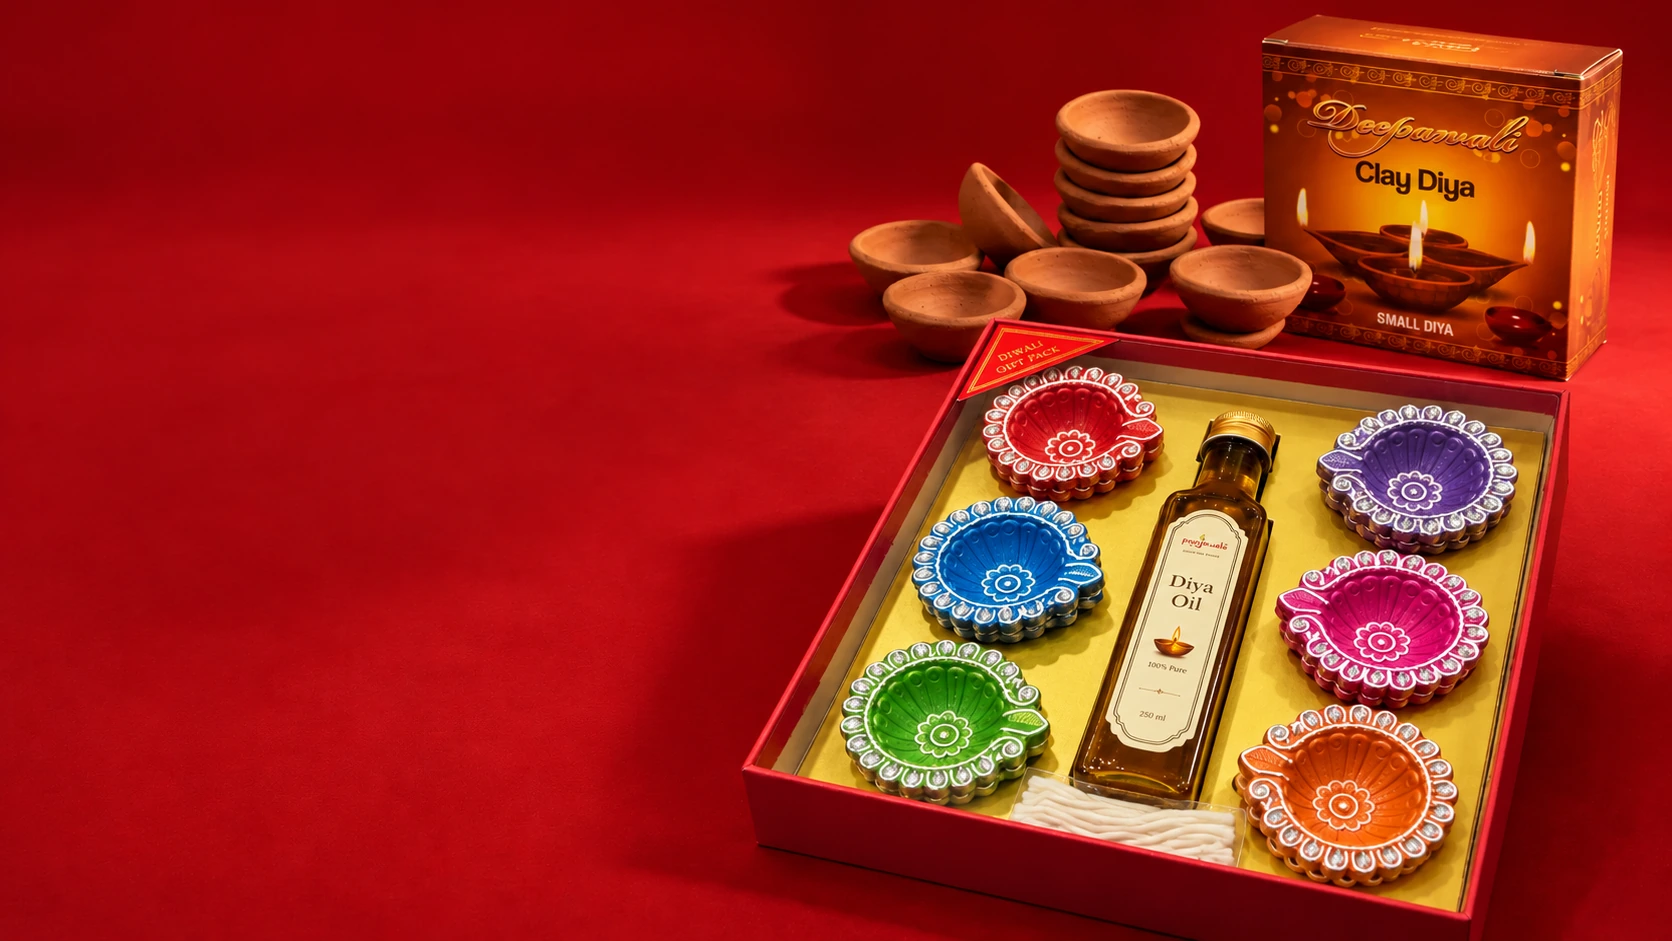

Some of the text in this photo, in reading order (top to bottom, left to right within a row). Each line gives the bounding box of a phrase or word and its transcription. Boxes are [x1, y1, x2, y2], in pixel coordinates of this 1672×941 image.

[1355, 161, 1475, 202] Clay Diya
[1377, 312, 1454, 336] SMALL DIYA
[998, 340, 1044, 361] DIWALI
[1027, 346, 1061, 362] PACK
[1169, 574, 1213, 594] Diya
[1171, 594, 1202, 611] Oil
[1148, 661, 1188, 674] 100% Pure
[1139, 710, 1167, 722] 250 ml
